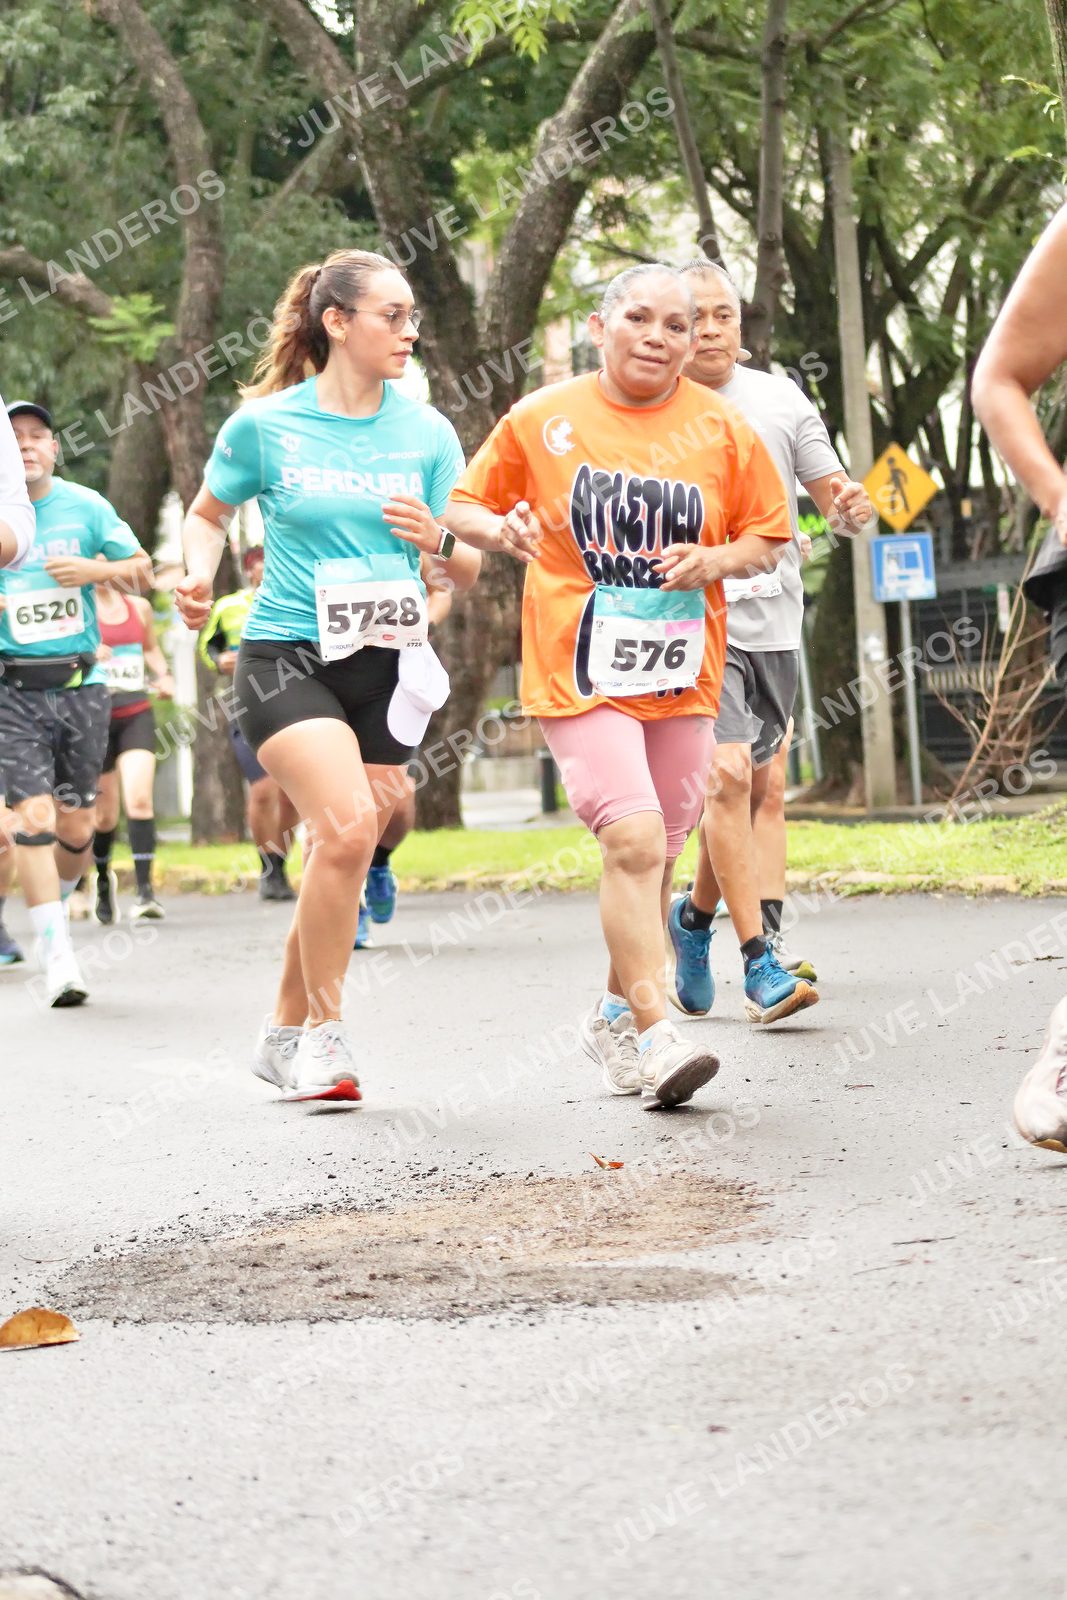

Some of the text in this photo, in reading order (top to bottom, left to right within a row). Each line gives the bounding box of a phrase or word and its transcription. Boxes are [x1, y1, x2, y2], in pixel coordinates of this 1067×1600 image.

[281, 466, 424, 497] PERDURA
[16, 598, 79, 626] 6520
[327, 597, 421, 635] 5728
[610, 638, 689, 672] 576
